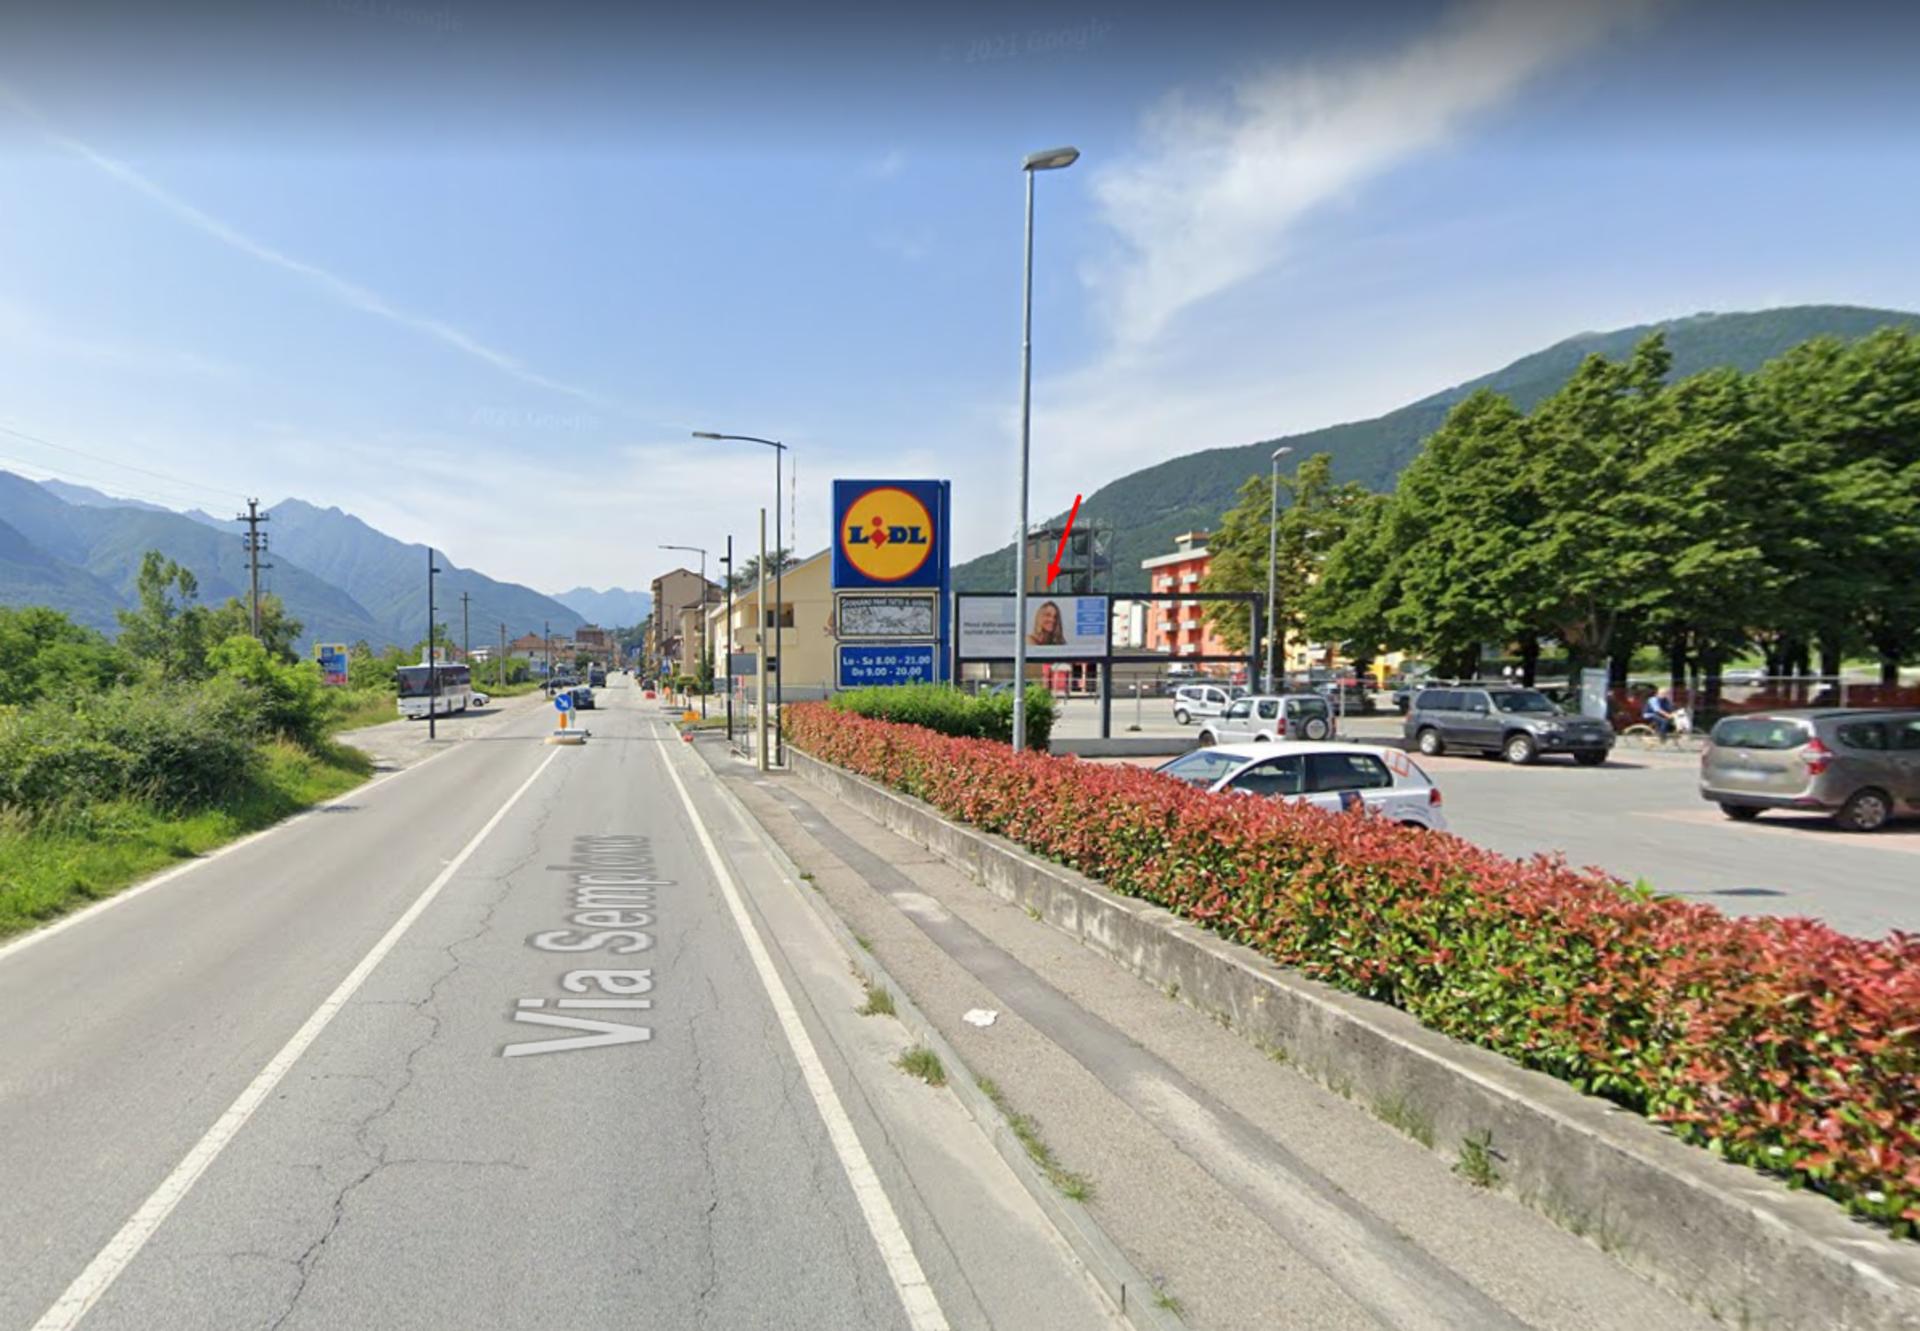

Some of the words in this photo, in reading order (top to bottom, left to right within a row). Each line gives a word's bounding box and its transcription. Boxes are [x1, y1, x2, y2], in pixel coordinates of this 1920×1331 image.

[875, 656, 896, 665] 8.00
[904, 655, 931, 665] 21.00
[866, 667, 887, 676] 9.00
